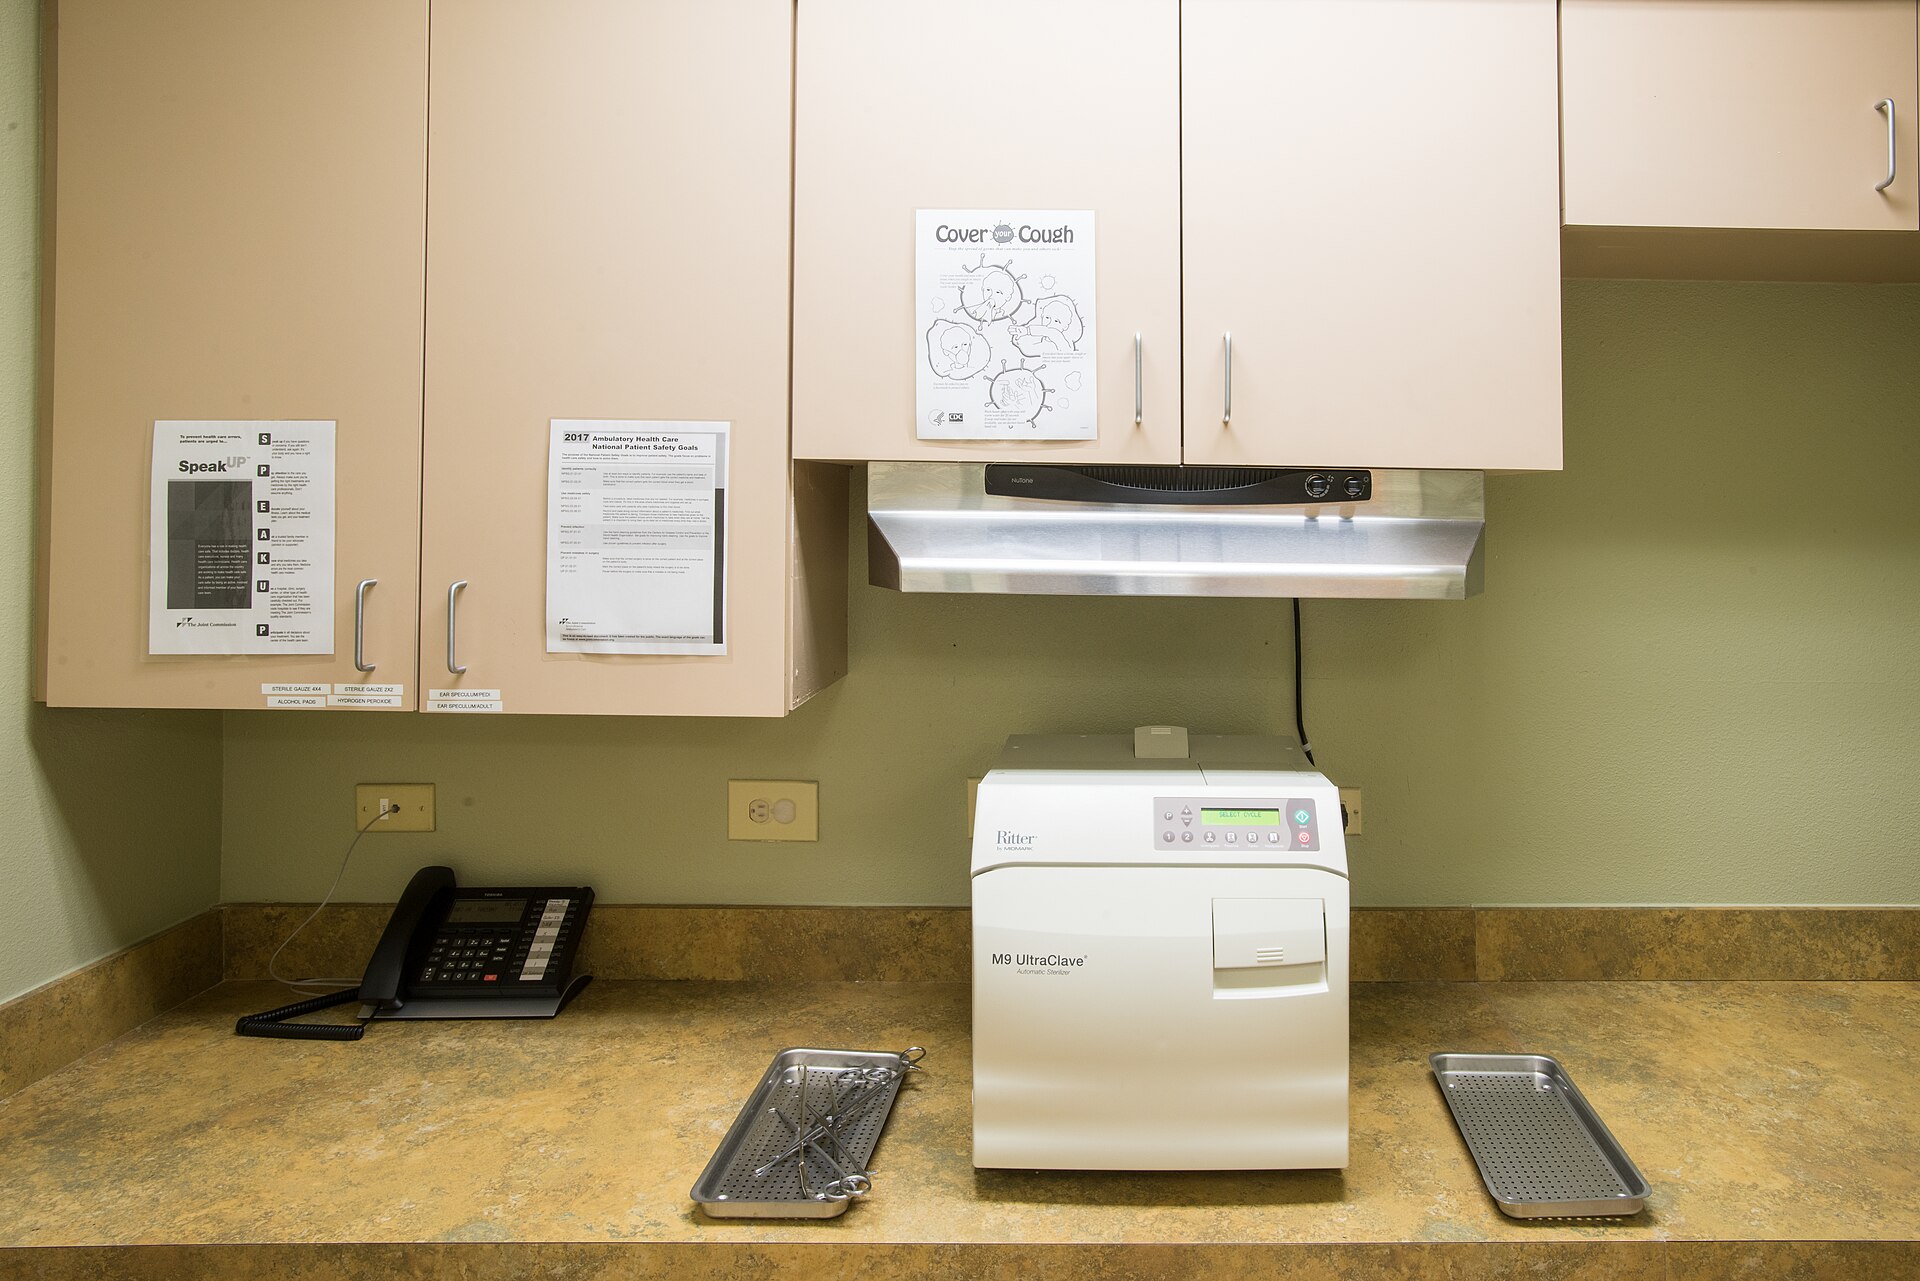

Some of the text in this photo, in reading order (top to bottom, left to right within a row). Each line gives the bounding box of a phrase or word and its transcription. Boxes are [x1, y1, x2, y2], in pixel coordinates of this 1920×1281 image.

[936, 225, 1074, 242] Cover your Cough
[261, 435, 268, 443] S
[179, 460, 227, 474] Speak
[260, 582, 266, 590] U
[997, 831, 1035, 844] Ritter
[992, 954, 1011, 966] M9
